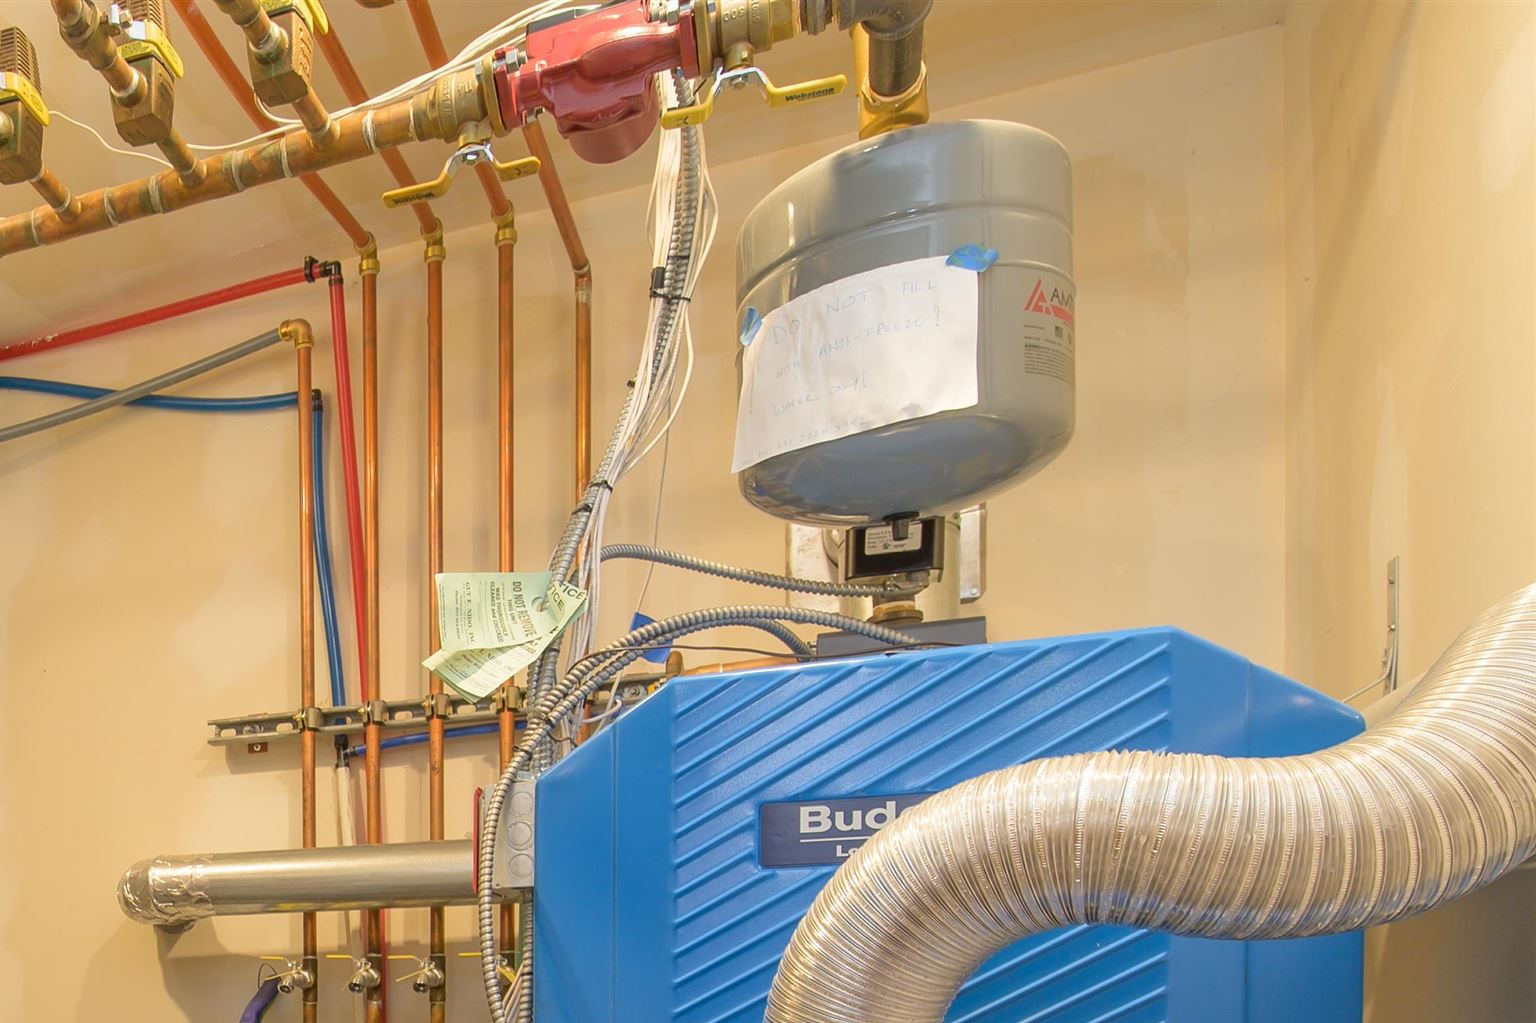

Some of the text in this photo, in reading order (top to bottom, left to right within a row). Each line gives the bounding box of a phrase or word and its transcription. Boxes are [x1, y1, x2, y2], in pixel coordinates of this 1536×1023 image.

[771, 280, 939, 345] DO NOT FILL
[493, 619, 504, 643] CHECKED
[497, 602, 509, 637] THOROUGHLY
[512, 581, 538, 638] DO NOT REMOVE
